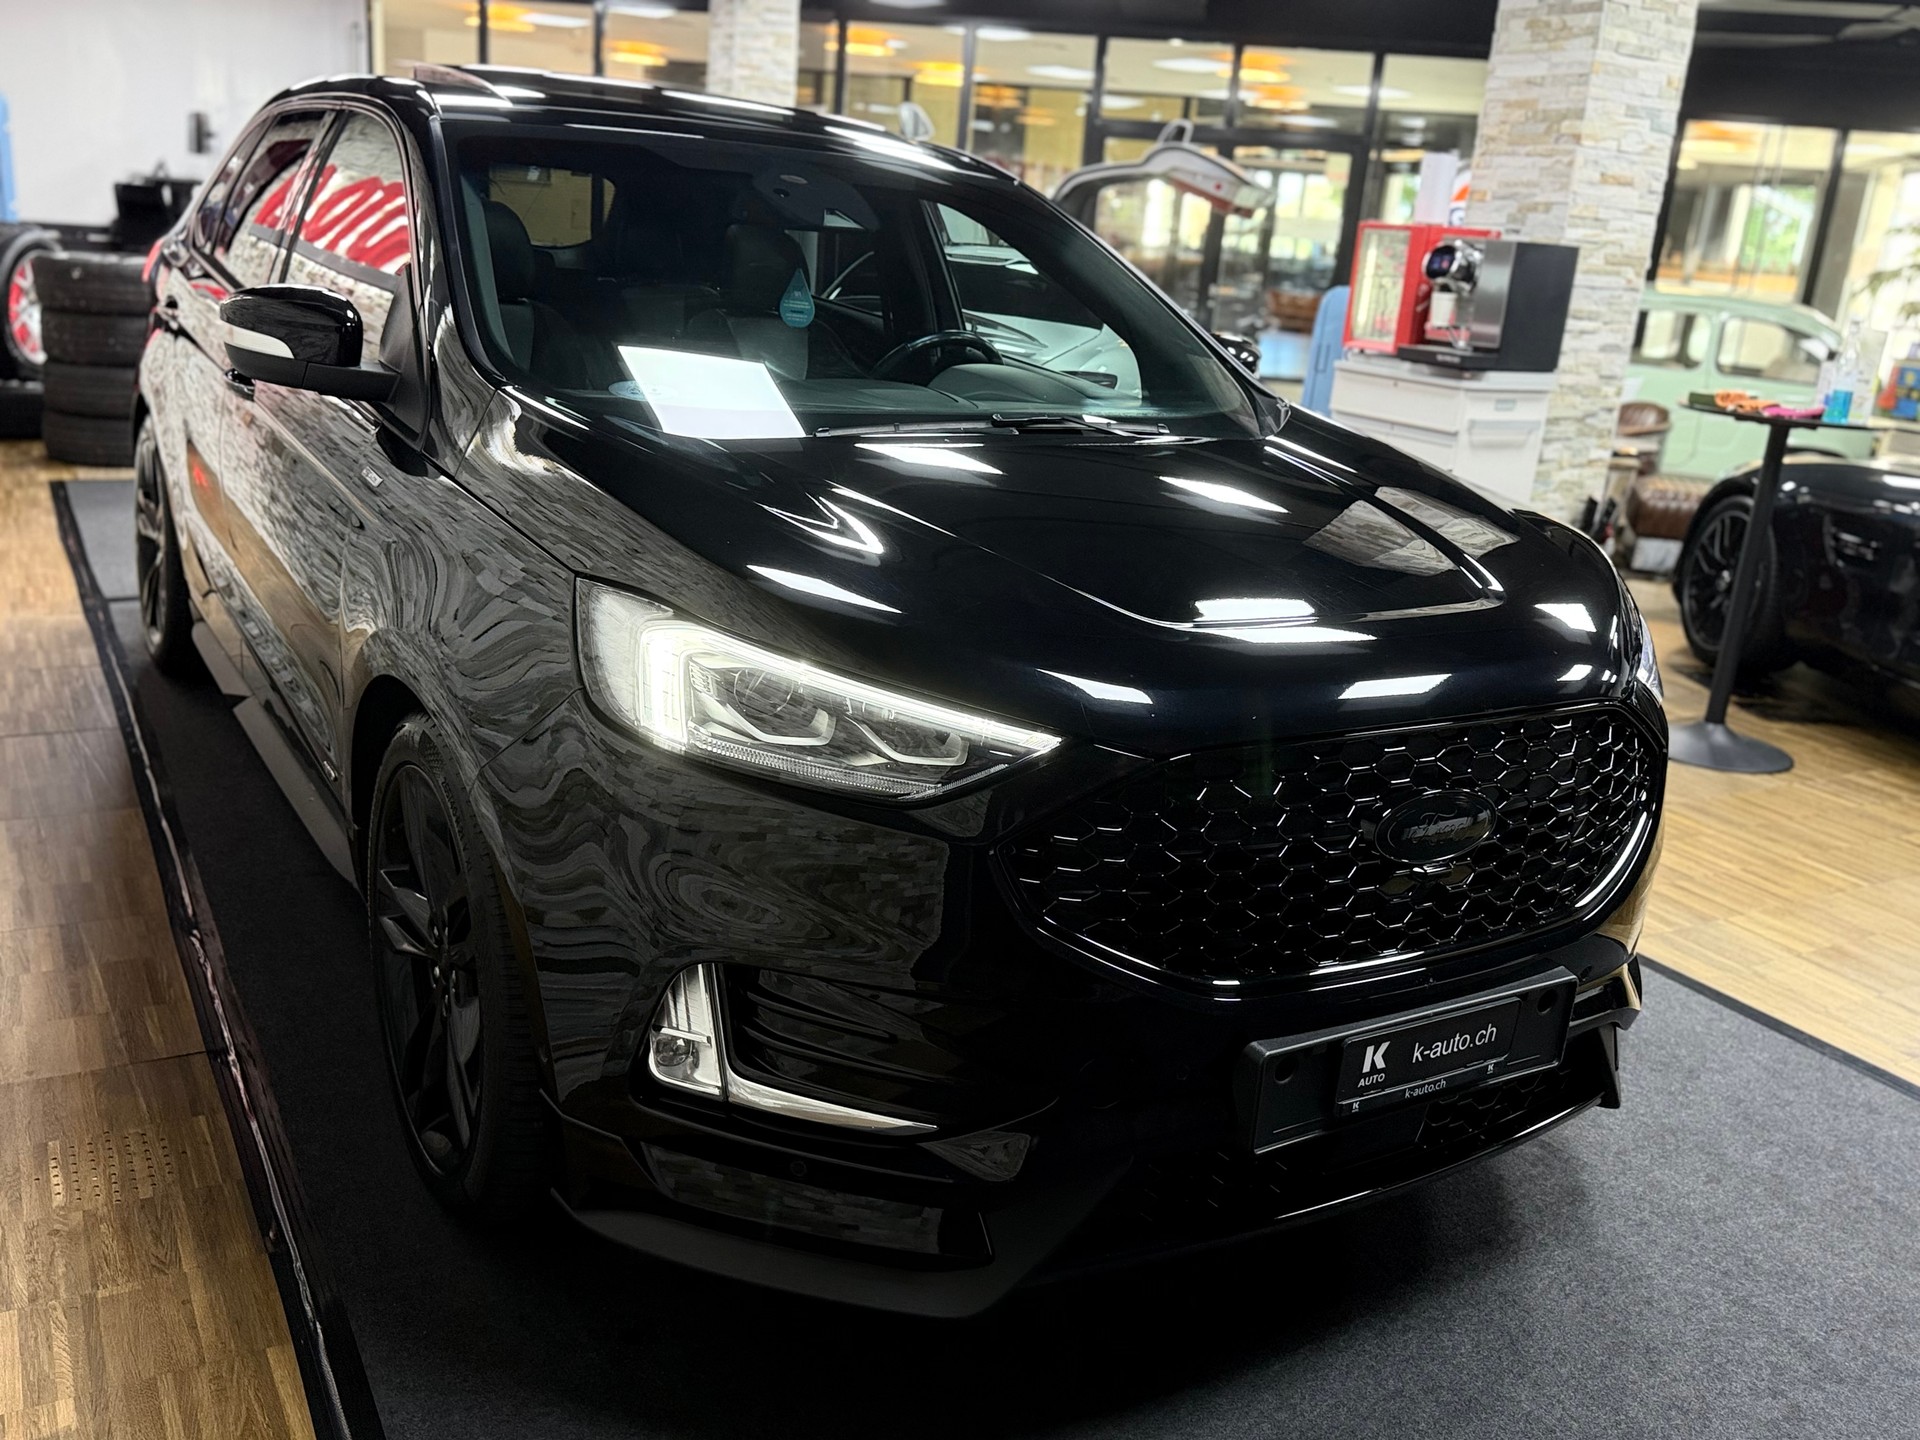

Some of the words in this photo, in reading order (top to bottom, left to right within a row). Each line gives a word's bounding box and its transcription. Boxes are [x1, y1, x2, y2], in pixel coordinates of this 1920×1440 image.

[1412, 1023, 1497, 1063] k-auto.ch
[1362, 1041, 1390, 1073] K
[1357, 1073, 1386, 1088] AUTO
[1404, 1079, 1447, 1099] k-auto.ch
